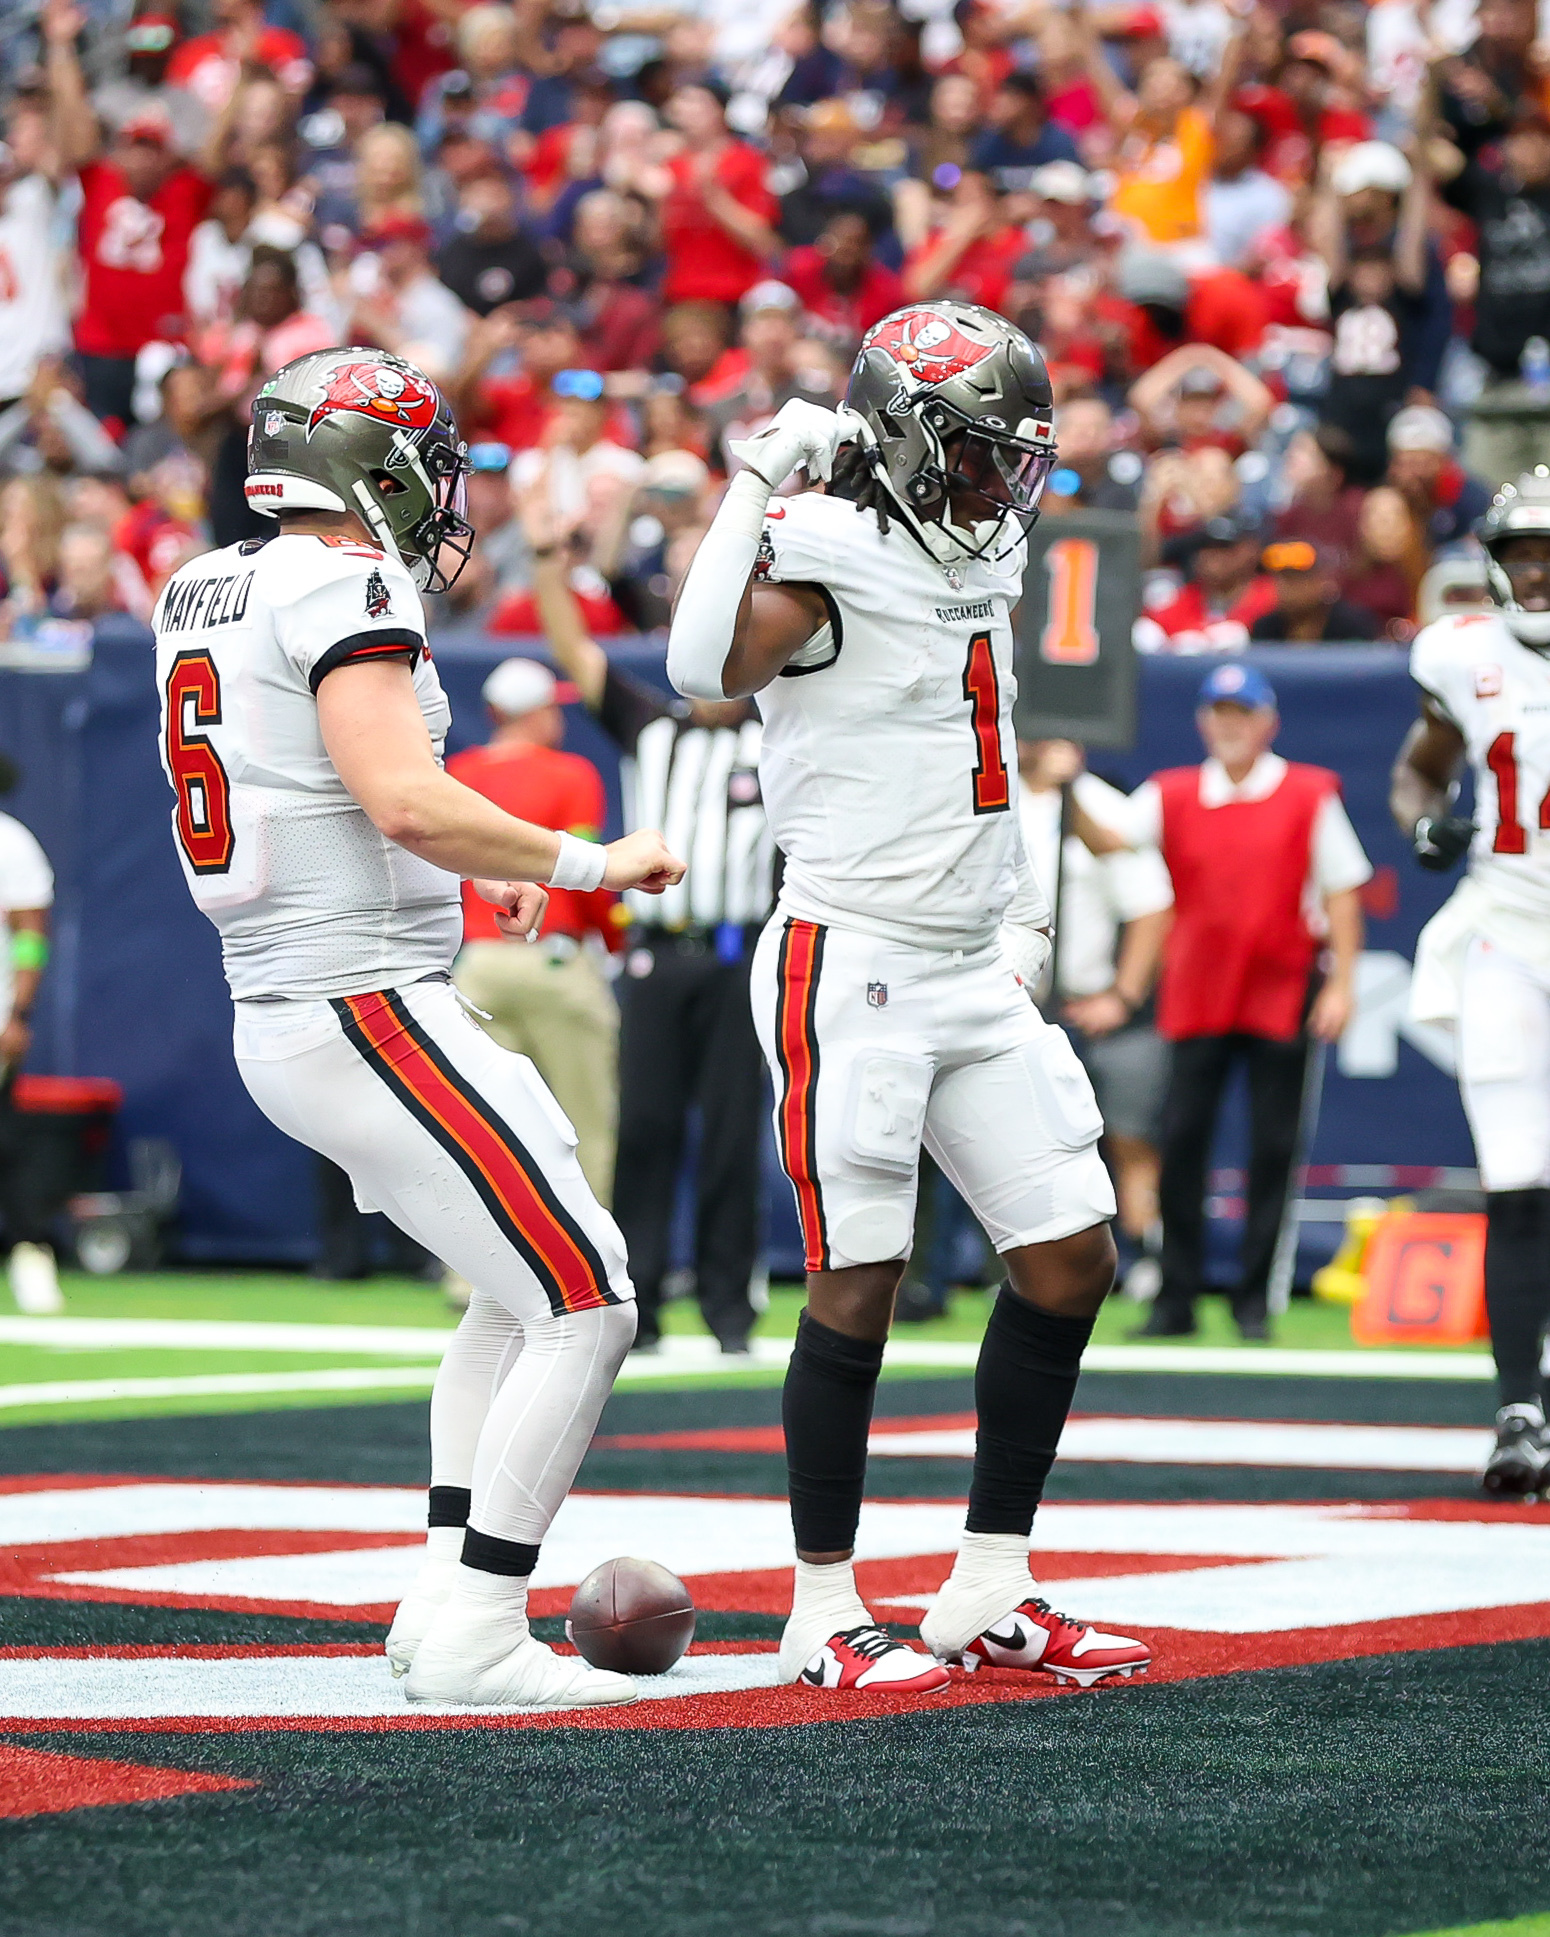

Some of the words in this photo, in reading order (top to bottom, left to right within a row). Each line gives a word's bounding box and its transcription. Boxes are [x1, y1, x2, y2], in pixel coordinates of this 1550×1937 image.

[160, 569, 256, 634] MAYFIELD
[1040, 538, 1099, 665] 1
[166, 648, 236, 876] 6
[962, 630, 1010, 816] 1
